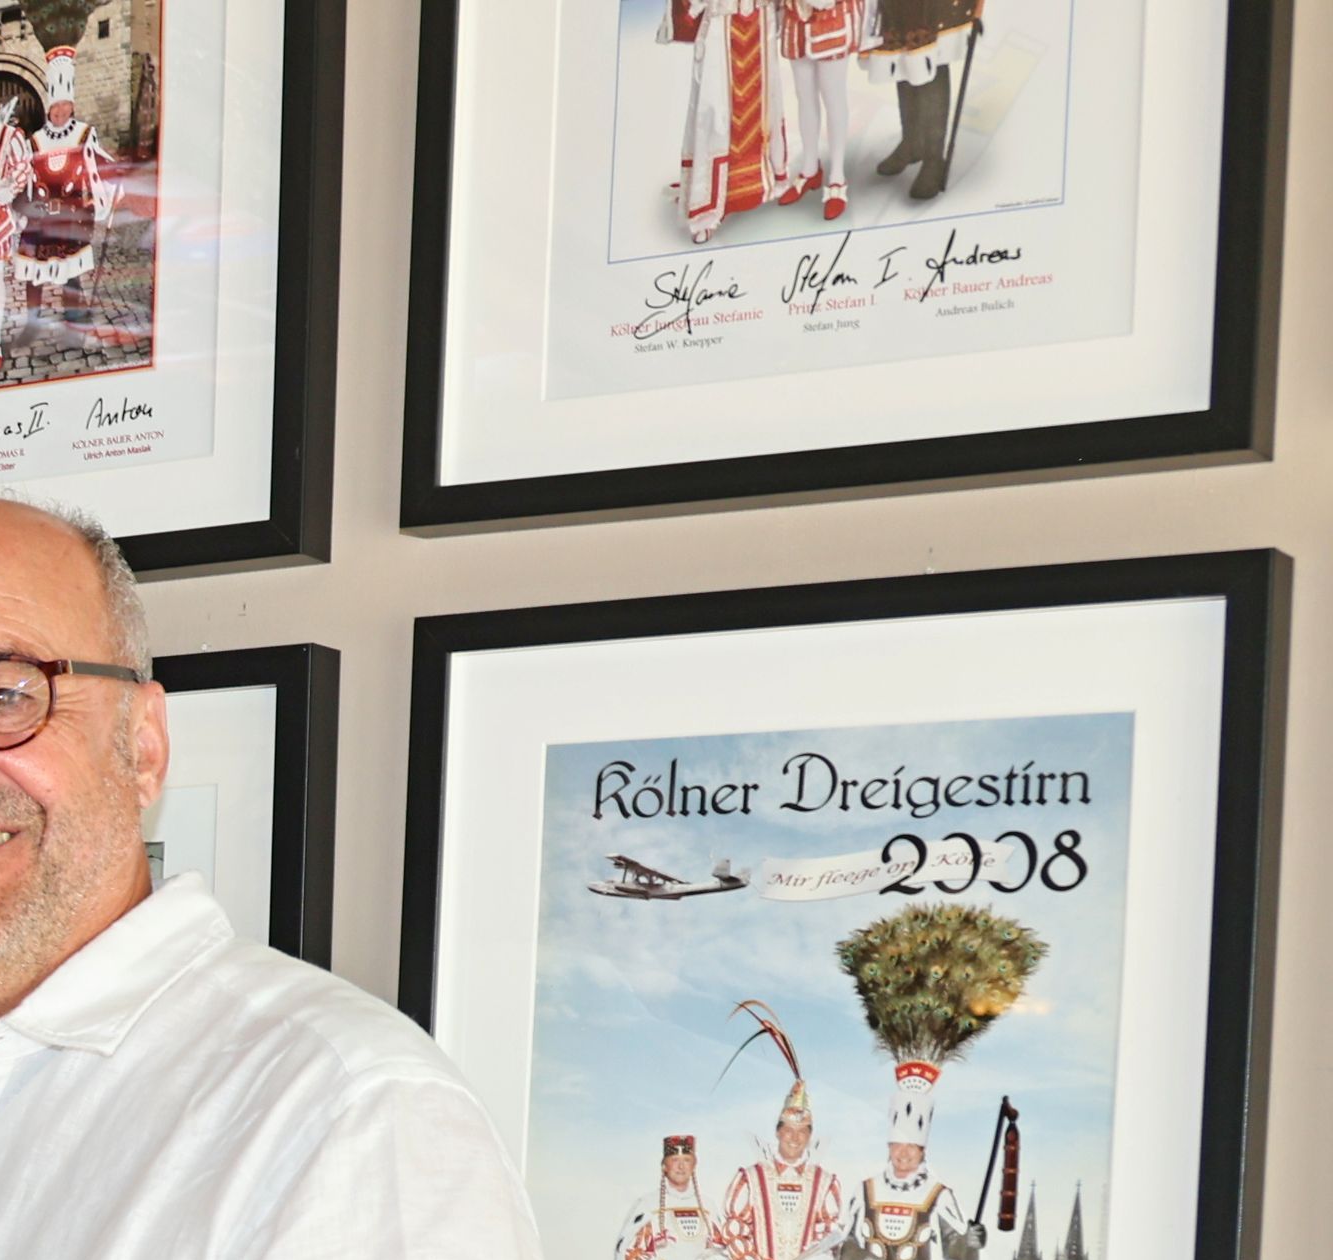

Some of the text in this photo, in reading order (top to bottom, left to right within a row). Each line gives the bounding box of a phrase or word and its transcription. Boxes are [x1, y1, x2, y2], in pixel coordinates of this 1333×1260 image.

[952, 281, 991, 296] Bauer
[996, 272, 1054, 290] Andreas
[825, 296, 861, 311] Stefan
[935, 305, 978, 317] Andreas
[712, 308, 763, 325] Stefanie
[802, 318, 861, 333] Stefan Jung
[634, 341, 664, 354] Stefan
[683, 335, 724, 350] Knepper
[86, 397, 153, 430] Anton
[71, 429, 165, 450] KÖLNER BAUER ANTON
[104, 448, 127, 458] Anton
[592, 752, 1092, 820] Kölner Dreigestirn
[767, 872, 813, 888] Mir
[810, 866, 881, 892] fleege
[931, 851, 997, 868] Köle
[879, 829, 1088, 895] 2008
